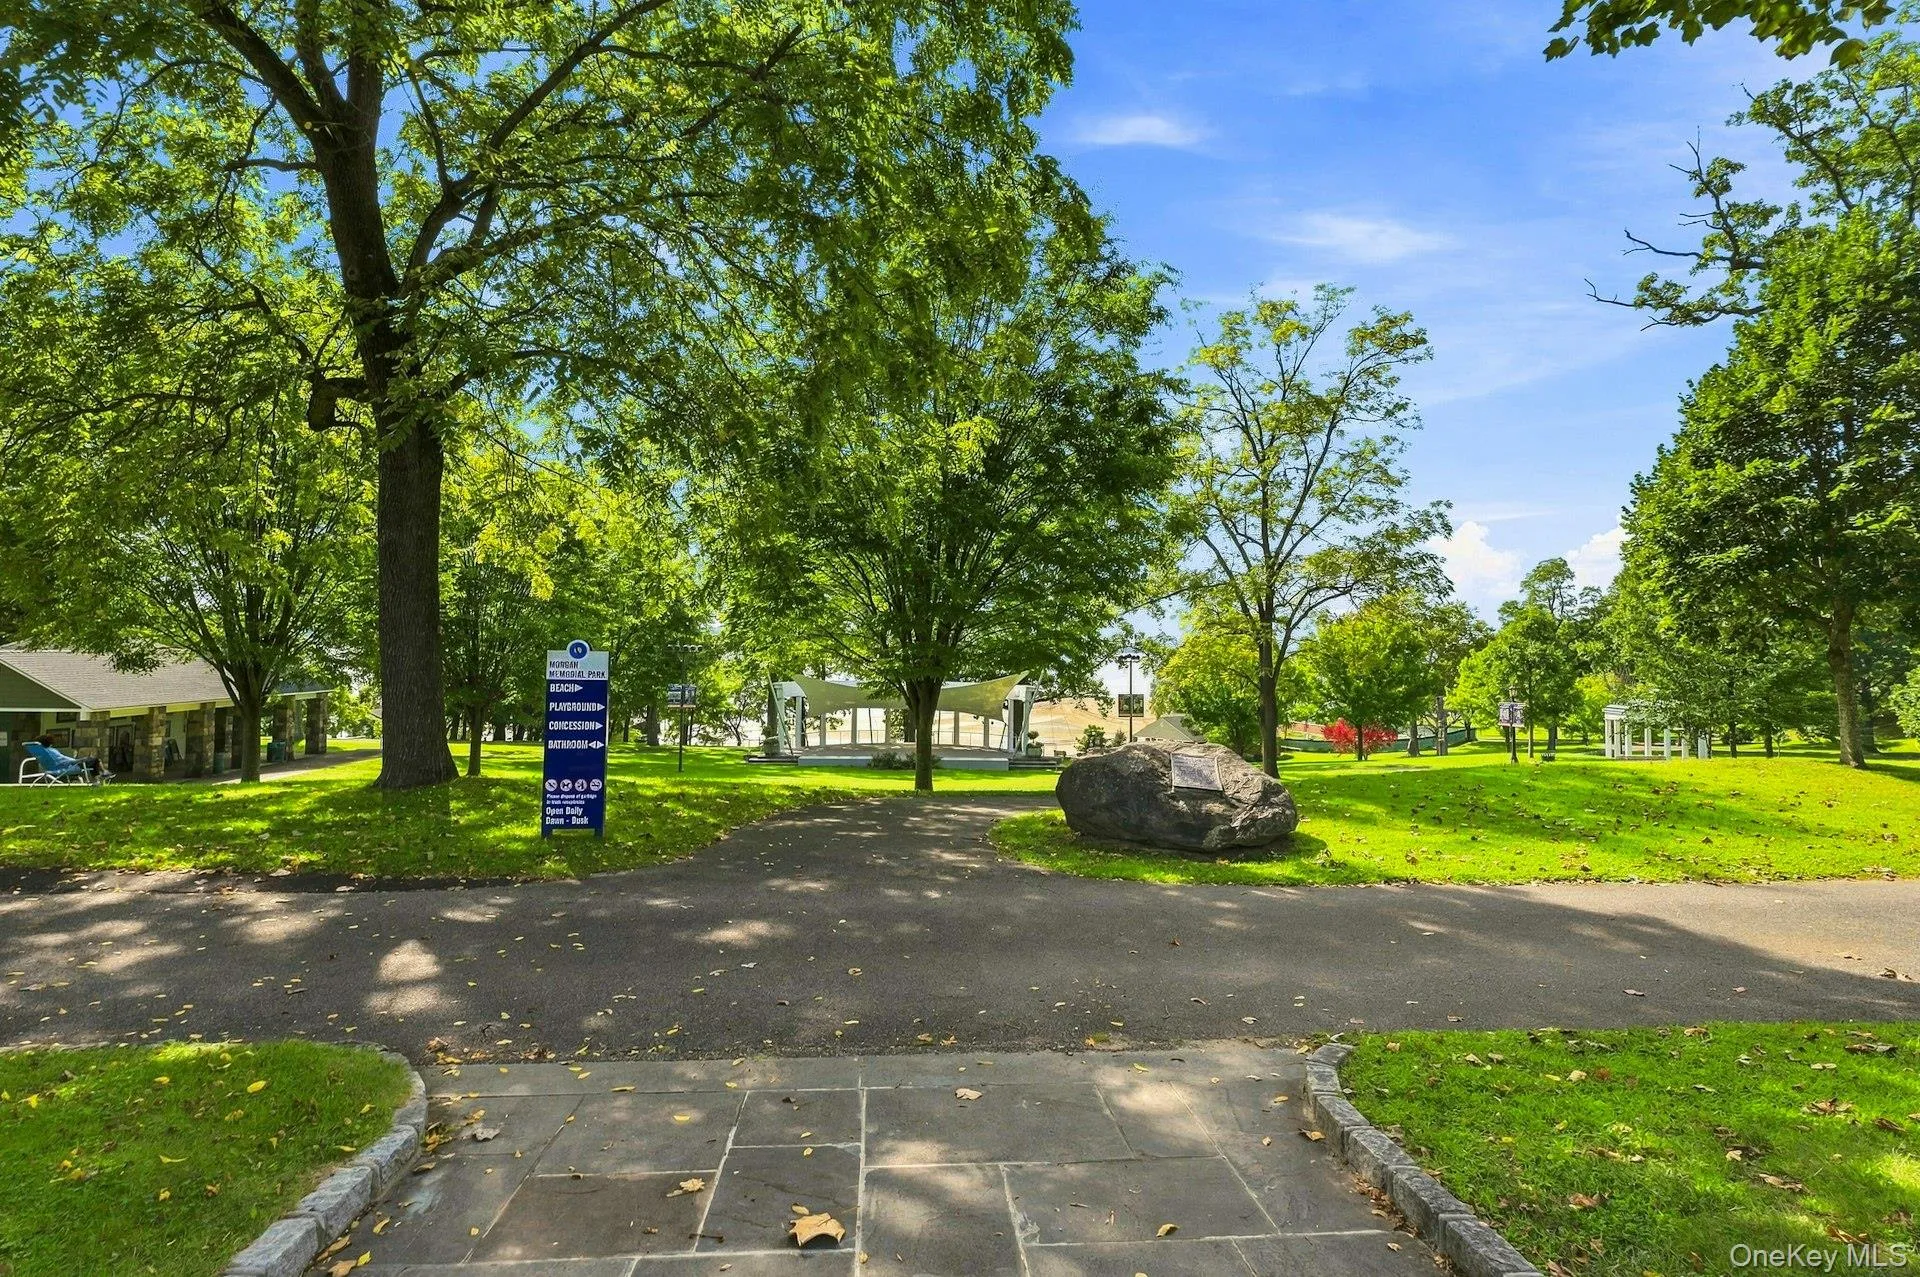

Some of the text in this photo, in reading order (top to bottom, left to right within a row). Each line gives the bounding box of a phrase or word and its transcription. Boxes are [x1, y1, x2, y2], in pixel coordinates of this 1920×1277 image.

[549, 661, 579, 669] MORGAN
[549, 670, 606, 679] MEMORIAL PARK
[550, 683, 574, 693] BEACH
[549, 702, 597, 712] PLAYGROUND
[548, 721, 595, 731] CONCESSION
[548, 740, 589, 750] BATHROOM
[546, 807, 583, 816] Open Daily
[546, 817, 564, 825] Dawn
[572, 816, 589, 825] Dusk
